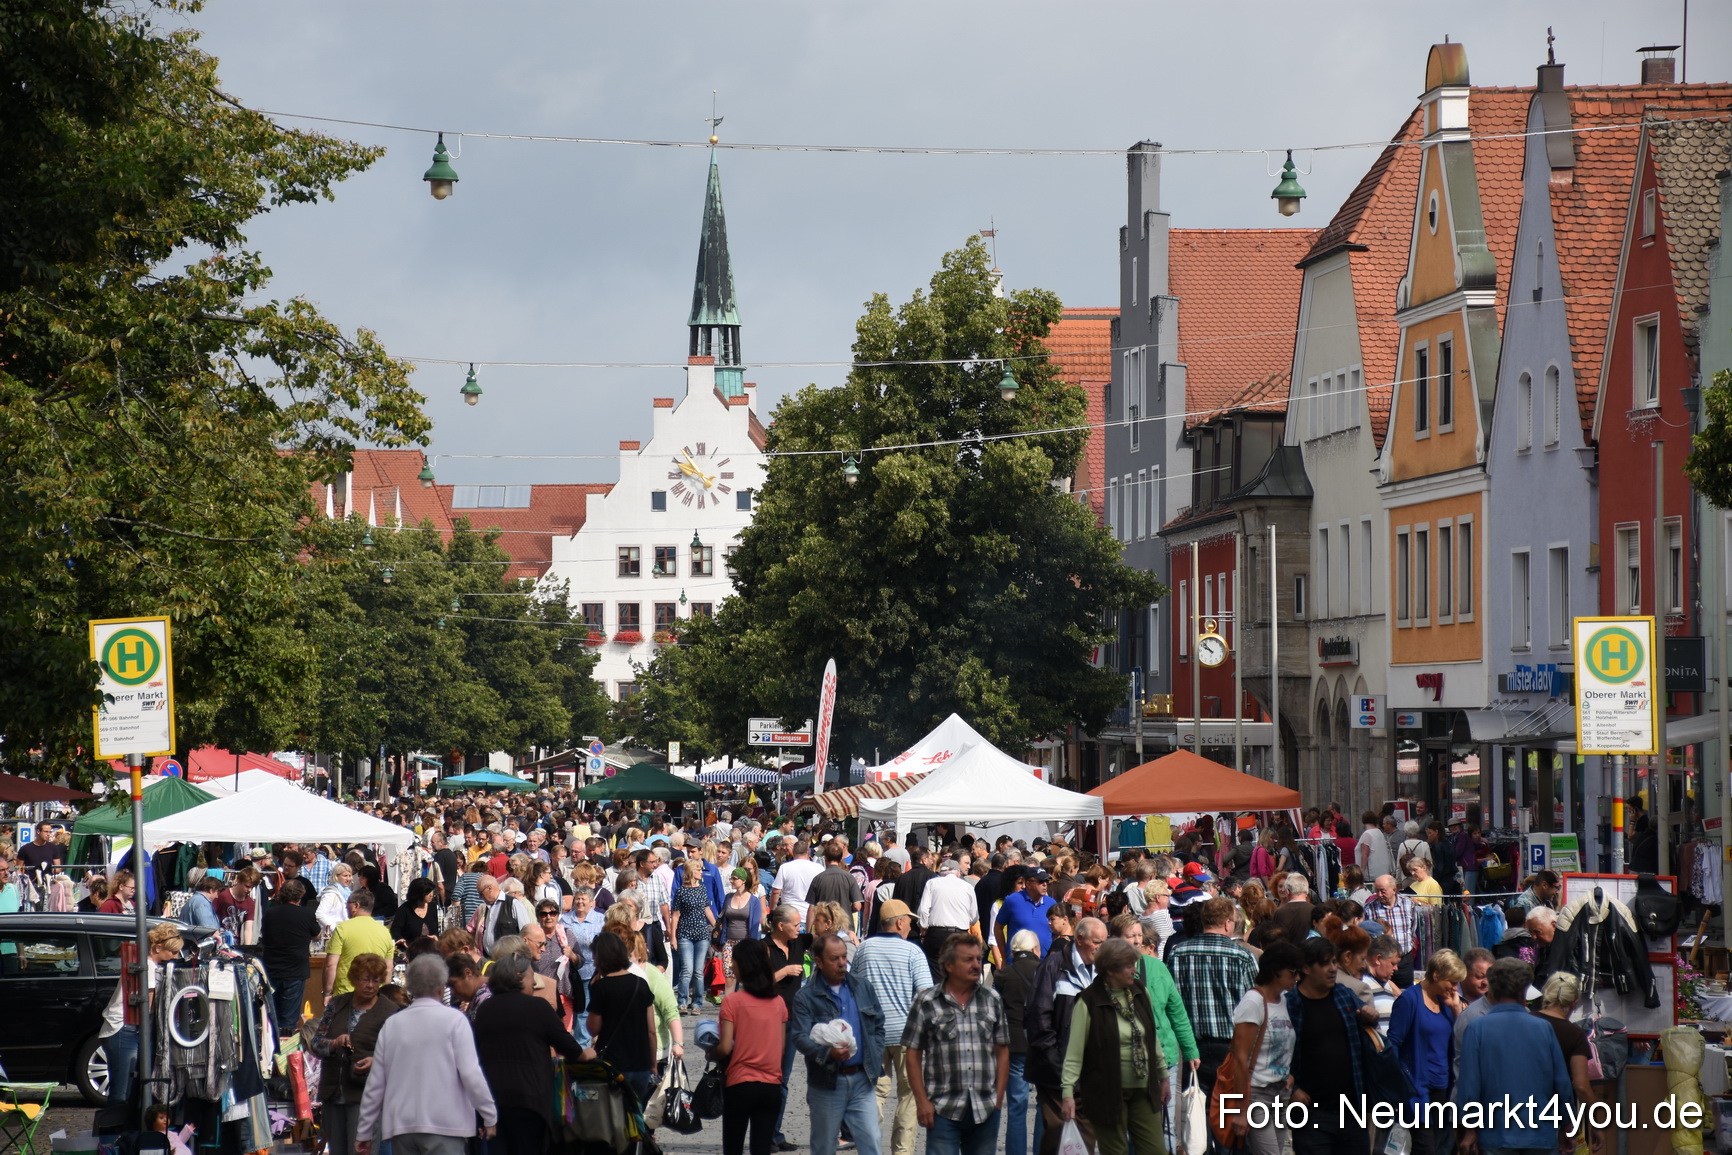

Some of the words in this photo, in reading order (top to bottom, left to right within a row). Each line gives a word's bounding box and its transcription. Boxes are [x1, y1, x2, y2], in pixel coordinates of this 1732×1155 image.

[117, 641, 145, 673] H
[1601, 640, 1629, 671] H
[1664, 666, 1699, 678] ONITA
[137, 691, 164, 700] Markt
[1584, 690, 1618, 699] Oberer
[1620, 690, 1647, 699] Markt
[774, 734, 802, 742] Rosengasse
[22, 830, 29, 841] P
[1534, 848, 1543, 862] P
